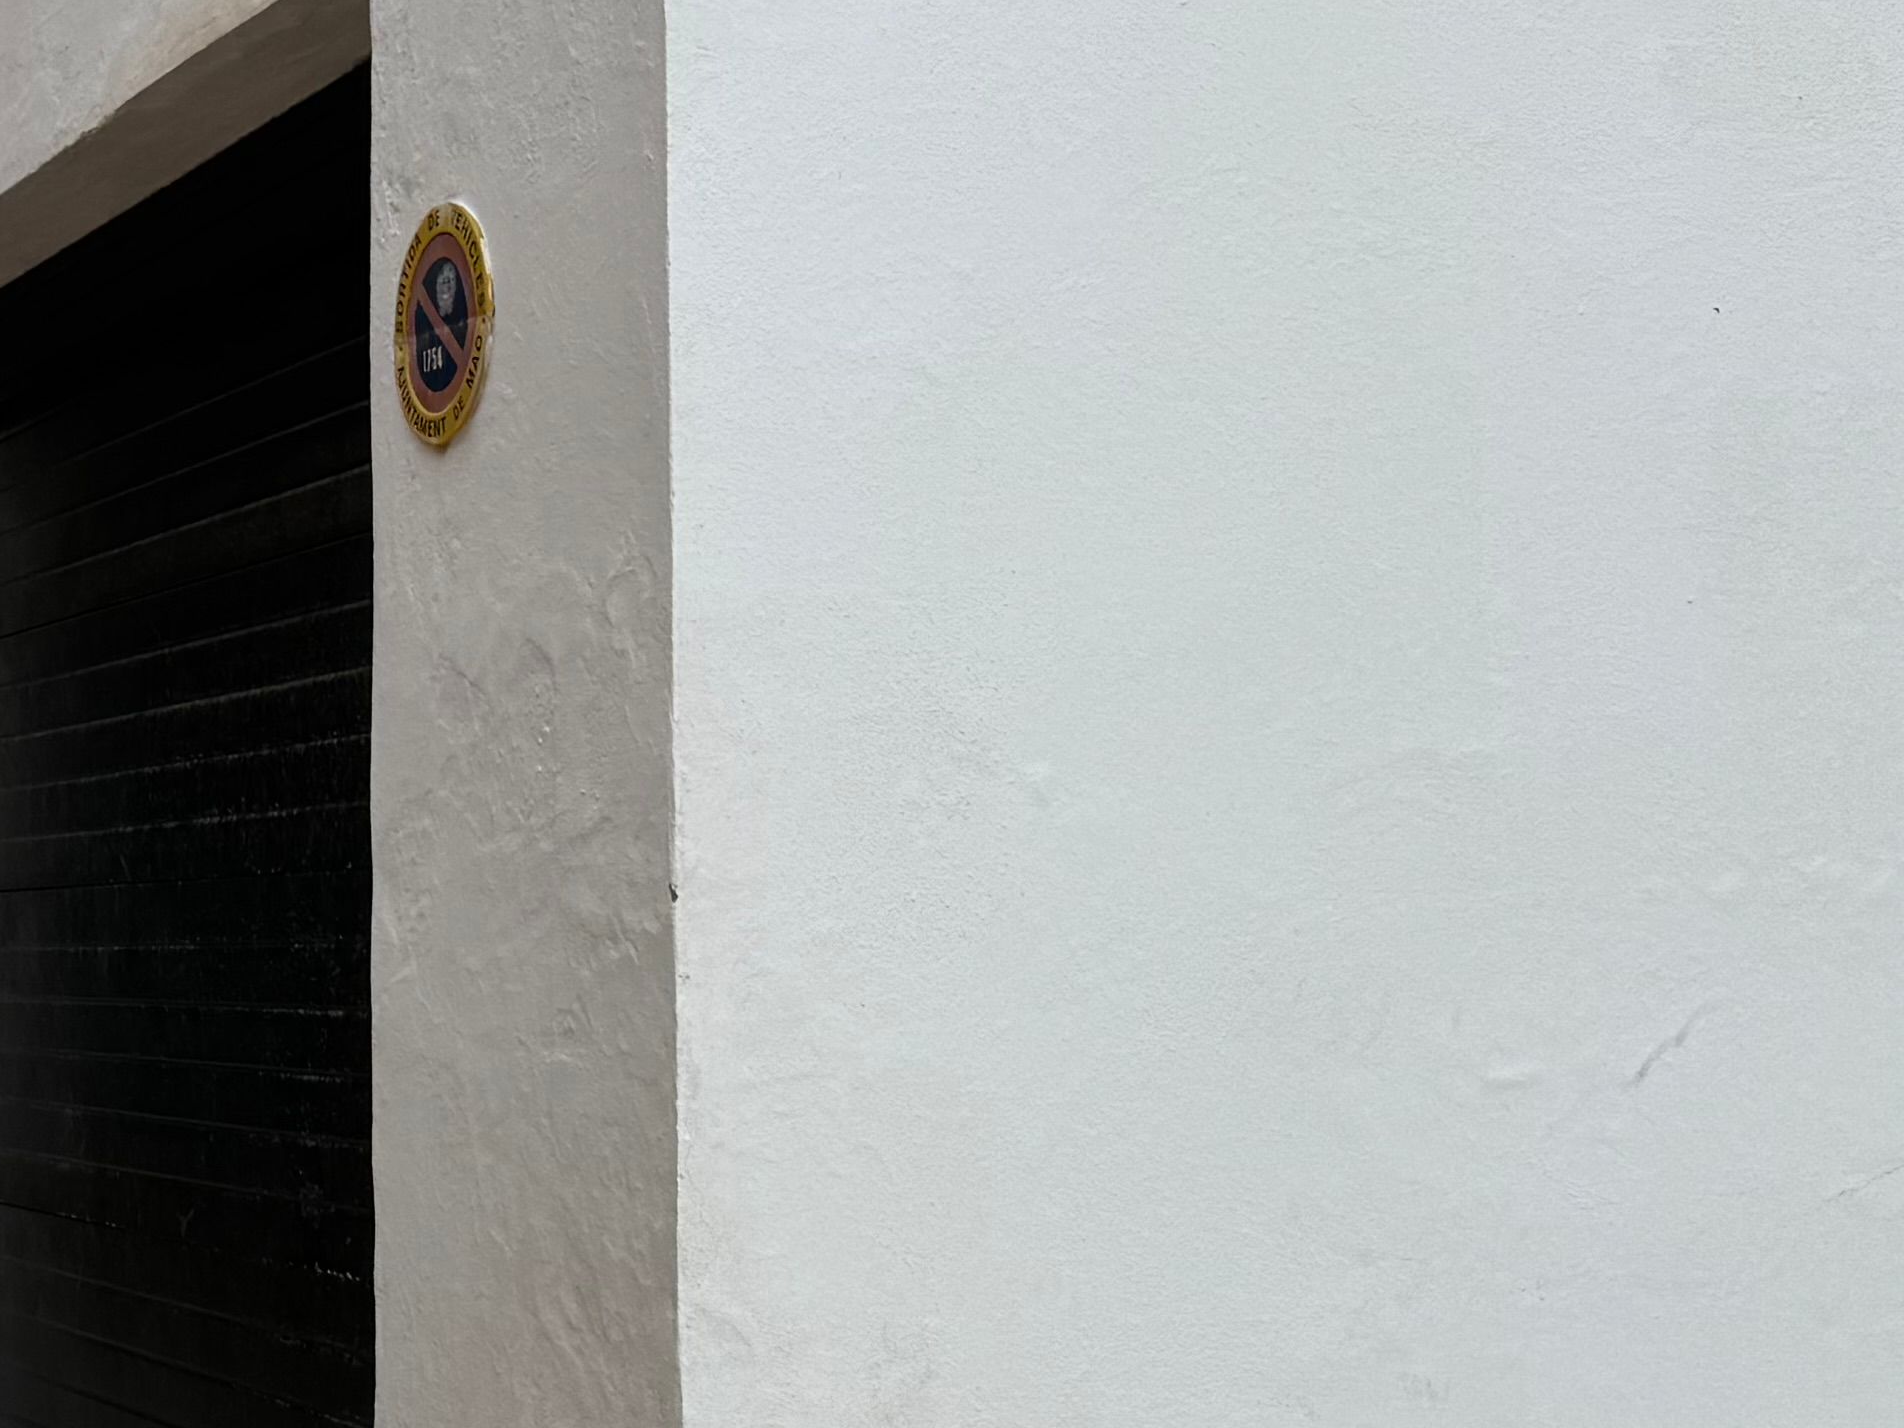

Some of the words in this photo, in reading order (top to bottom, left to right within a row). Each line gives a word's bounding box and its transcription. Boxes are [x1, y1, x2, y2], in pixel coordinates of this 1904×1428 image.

[428, 209, 440, 231] DE
[397, 366, 446, 438] AJUNTAMENT
[452, 395, 465, 421] DE
